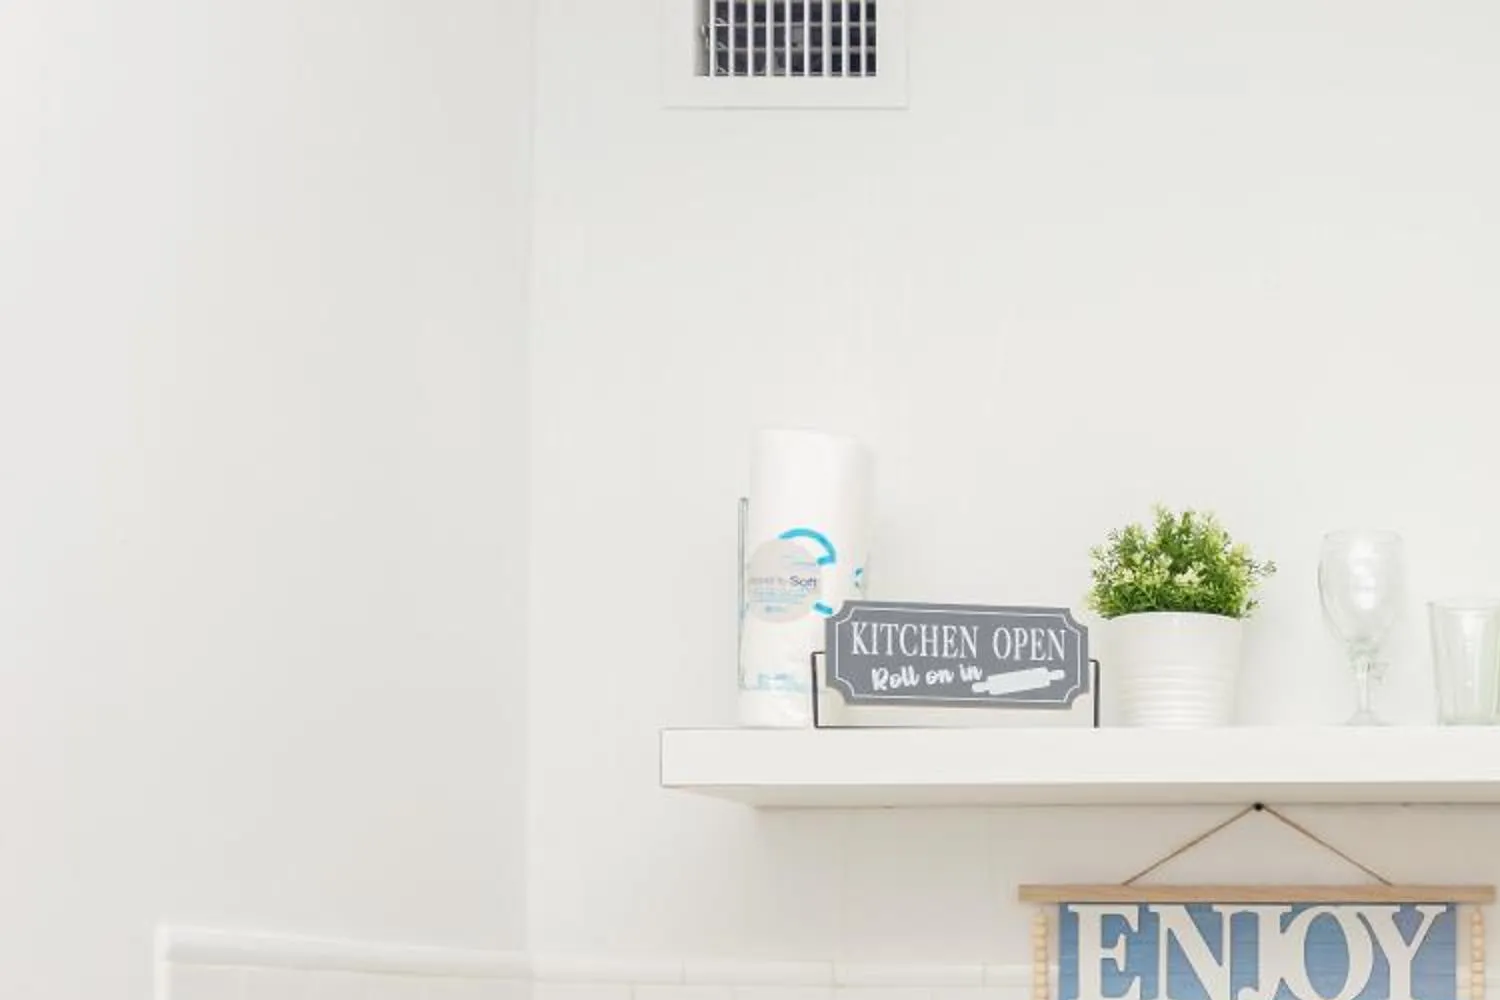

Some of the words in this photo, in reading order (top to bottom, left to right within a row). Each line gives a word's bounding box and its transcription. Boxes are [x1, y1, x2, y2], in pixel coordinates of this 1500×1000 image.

[851, 621, 979, 659] KITCHEN
[992, 626, 1067, 662] OPEN
[871, 664, 920, 692] Roll
[925, 668, 955, 686] on
[958, 662, 984, 683] in
